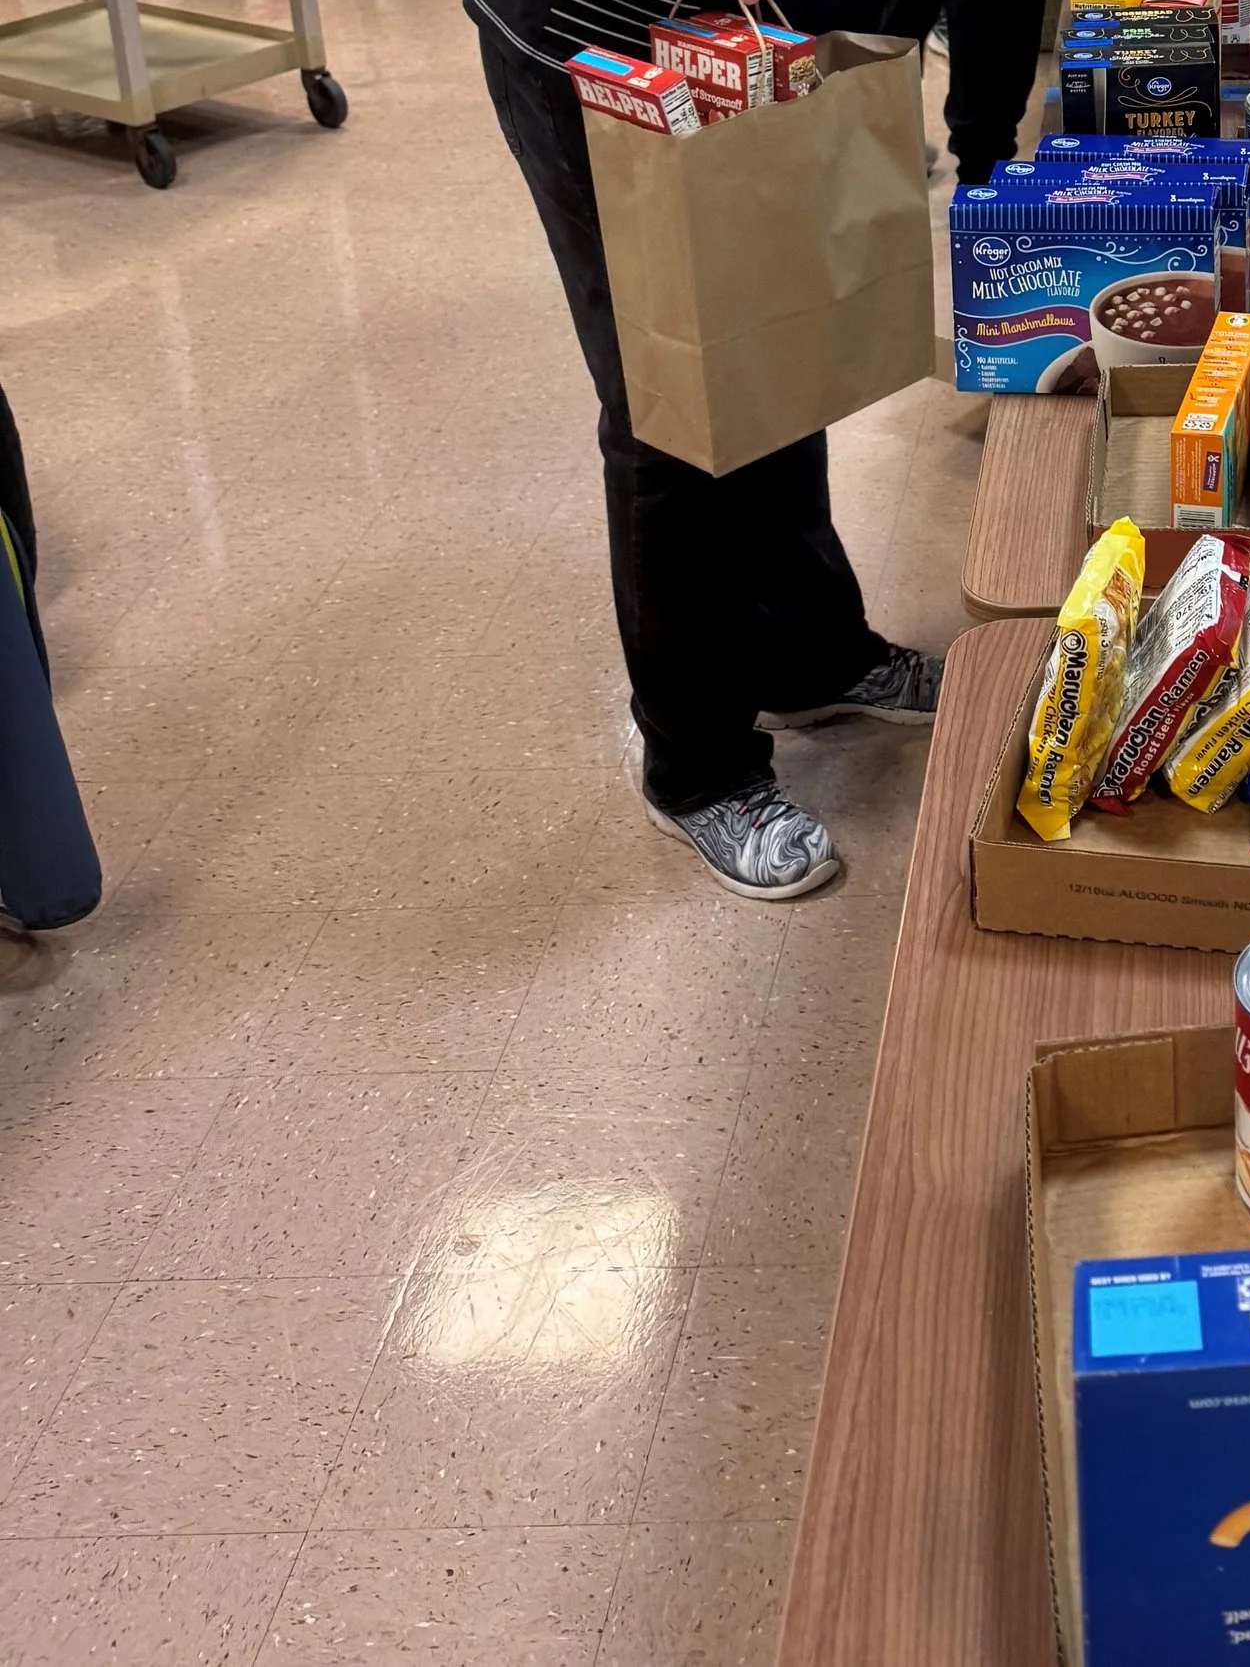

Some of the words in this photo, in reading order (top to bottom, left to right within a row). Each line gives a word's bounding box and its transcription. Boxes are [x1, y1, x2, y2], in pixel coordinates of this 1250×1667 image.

[655, 39, 742, 91] HELPER
[1149, 80, 1171, 94] Kroger
[576, 77, 665, 128] HELPER
[700, 91, 742, 111] Stroganoff
[1125, 111, 1196, 129] TURKEY
[1137, 127, 1184, 136] FLAVORED
[975, 242, 1008, 260] Kroger
[990, 268, 1009, 280] HOT
[1011, 261, 1043, 276] COCOA
[1045, 256, 1062, 269] MIX
[973, 281, 1008, 299] MILK
[1009, 270, 1082, 295] CHOCOLATE
[1047, 286, 1080, 297] FLAVORED
[976, 323, 1000, 336] Mini
[1001, 314, 1075, 333] Marshmallows
[1054, 652, 1088, 748] Maruchan
[1037, 705, 1056, 754] Chicken
[1103, 704, 1166, 792] Maruchan
[1160, 651, 1209, 708] Ramen
[1133, 738, 1160, 776] Roast
[1155, 713, 1176, 741] Beef
[1195, 737, 1218, 762] Flavor
[1187, 739, 1244, 797] Ramen
[1119, 891, 1178, 905] ALGOOD
[1181, 896, 1229, 910] Smooth
